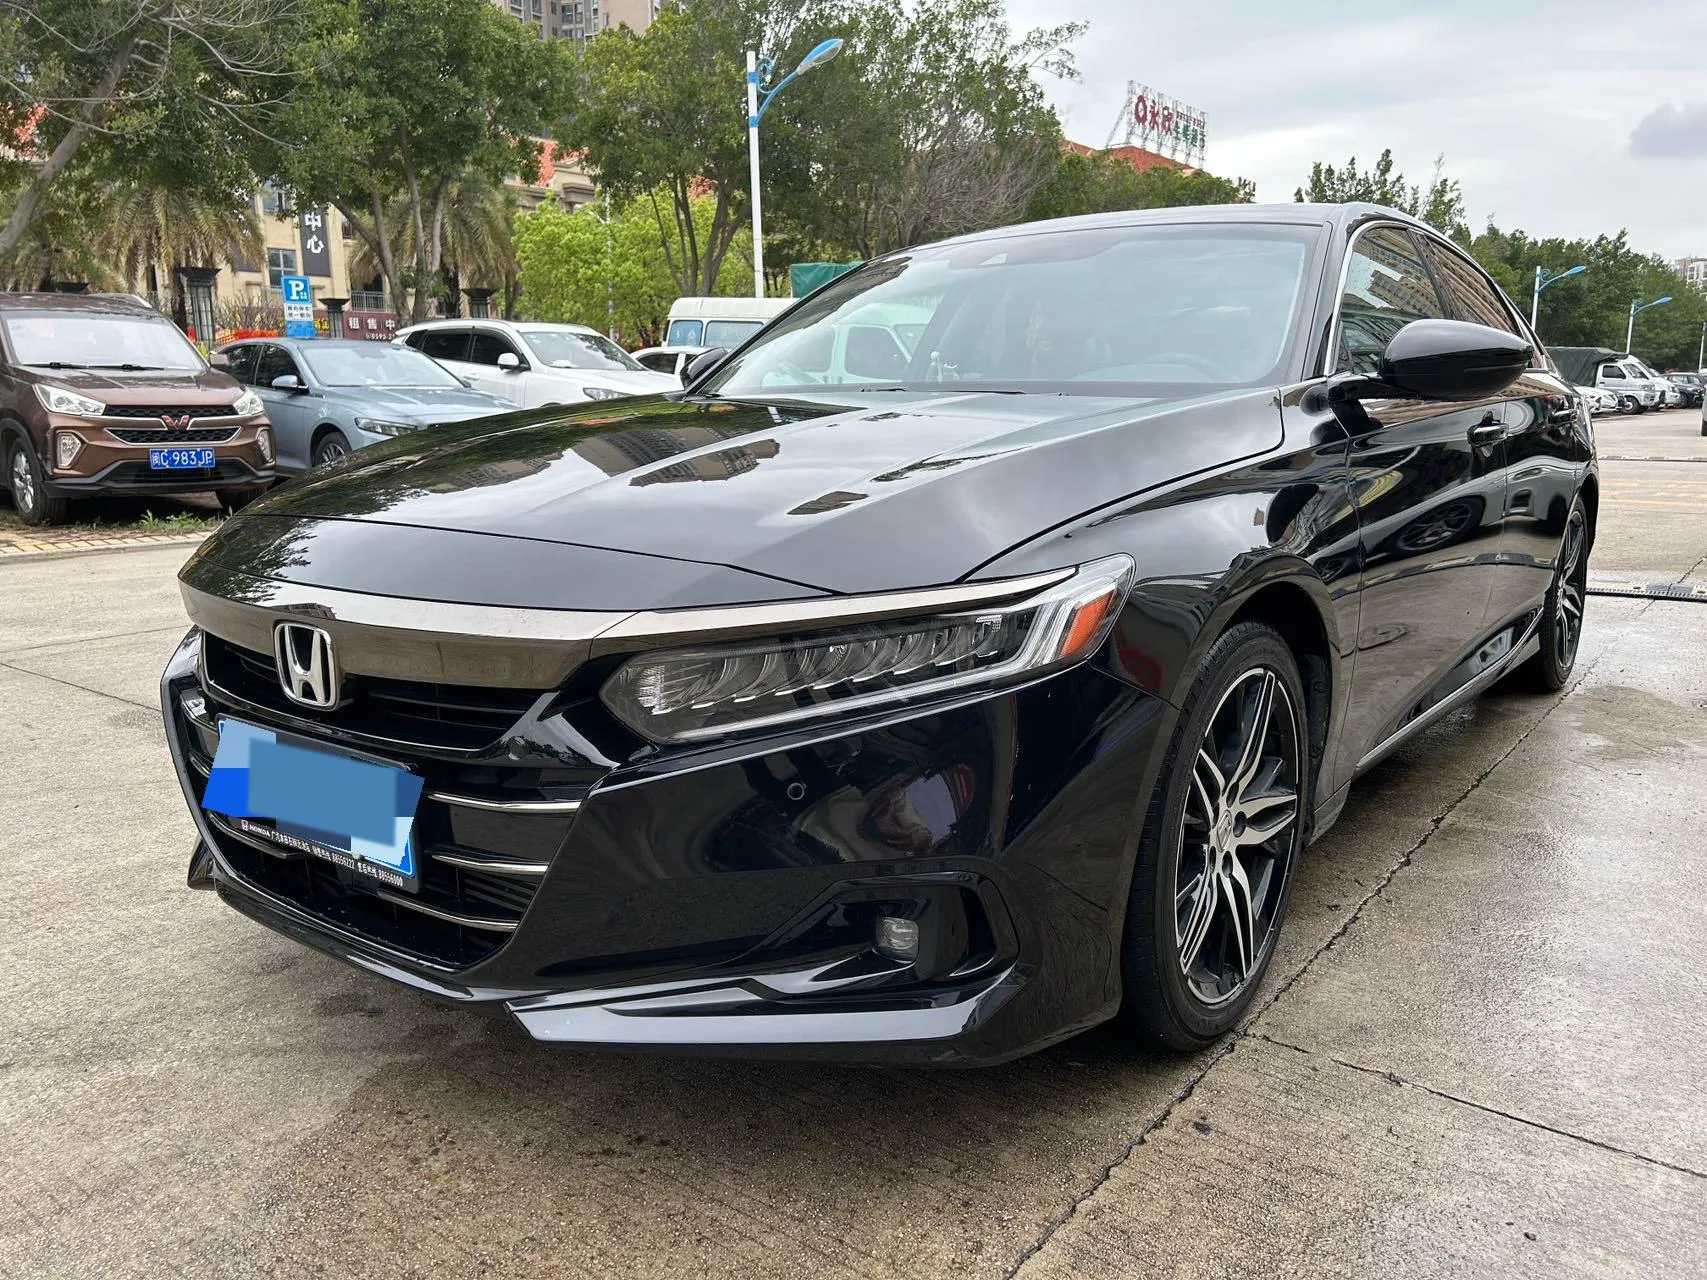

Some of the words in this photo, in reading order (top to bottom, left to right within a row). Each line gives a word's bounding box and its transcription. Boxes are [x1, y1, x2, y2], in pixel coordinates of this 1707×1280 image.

[304, 202, 324, 254] 中心
[289, 280, 305, 300] P
[249, 824, 271, 838] HONDA
